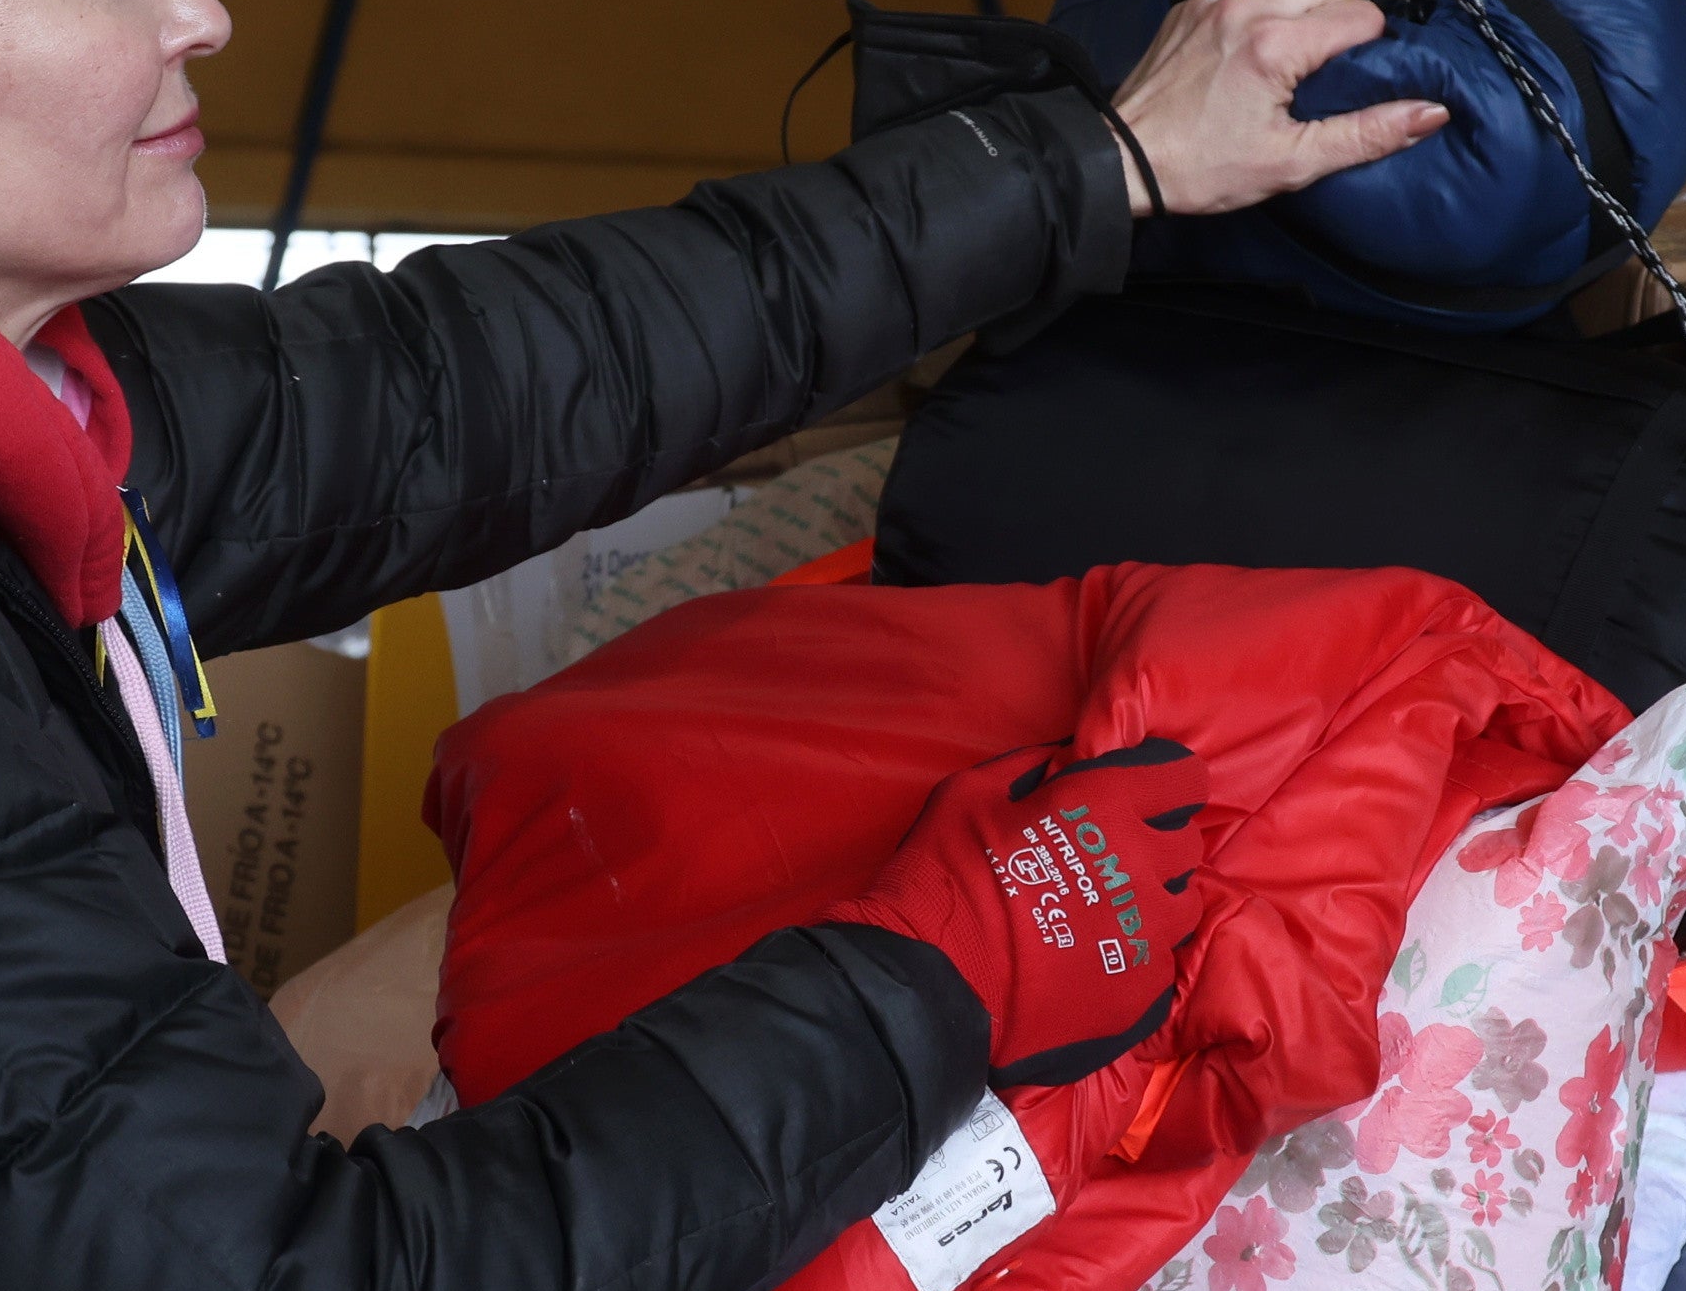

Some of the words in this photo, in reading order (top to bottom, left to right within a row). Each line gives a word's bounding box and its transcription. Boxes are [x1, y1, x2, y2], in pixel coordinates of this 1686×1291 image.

[1023, 828, 1038, 844] EN
[1036, 845, 1069, 895] 388:2016
[1040, 816, 1099, 906] NITRIPOR
[1060, 805, 1148, 966] JOMIBA
[1106, 949, 1120, 966] 10
[891, 1194, 921, 1216] TALLA
[905, 1210, 945, 1240] VISIBILIDAD
